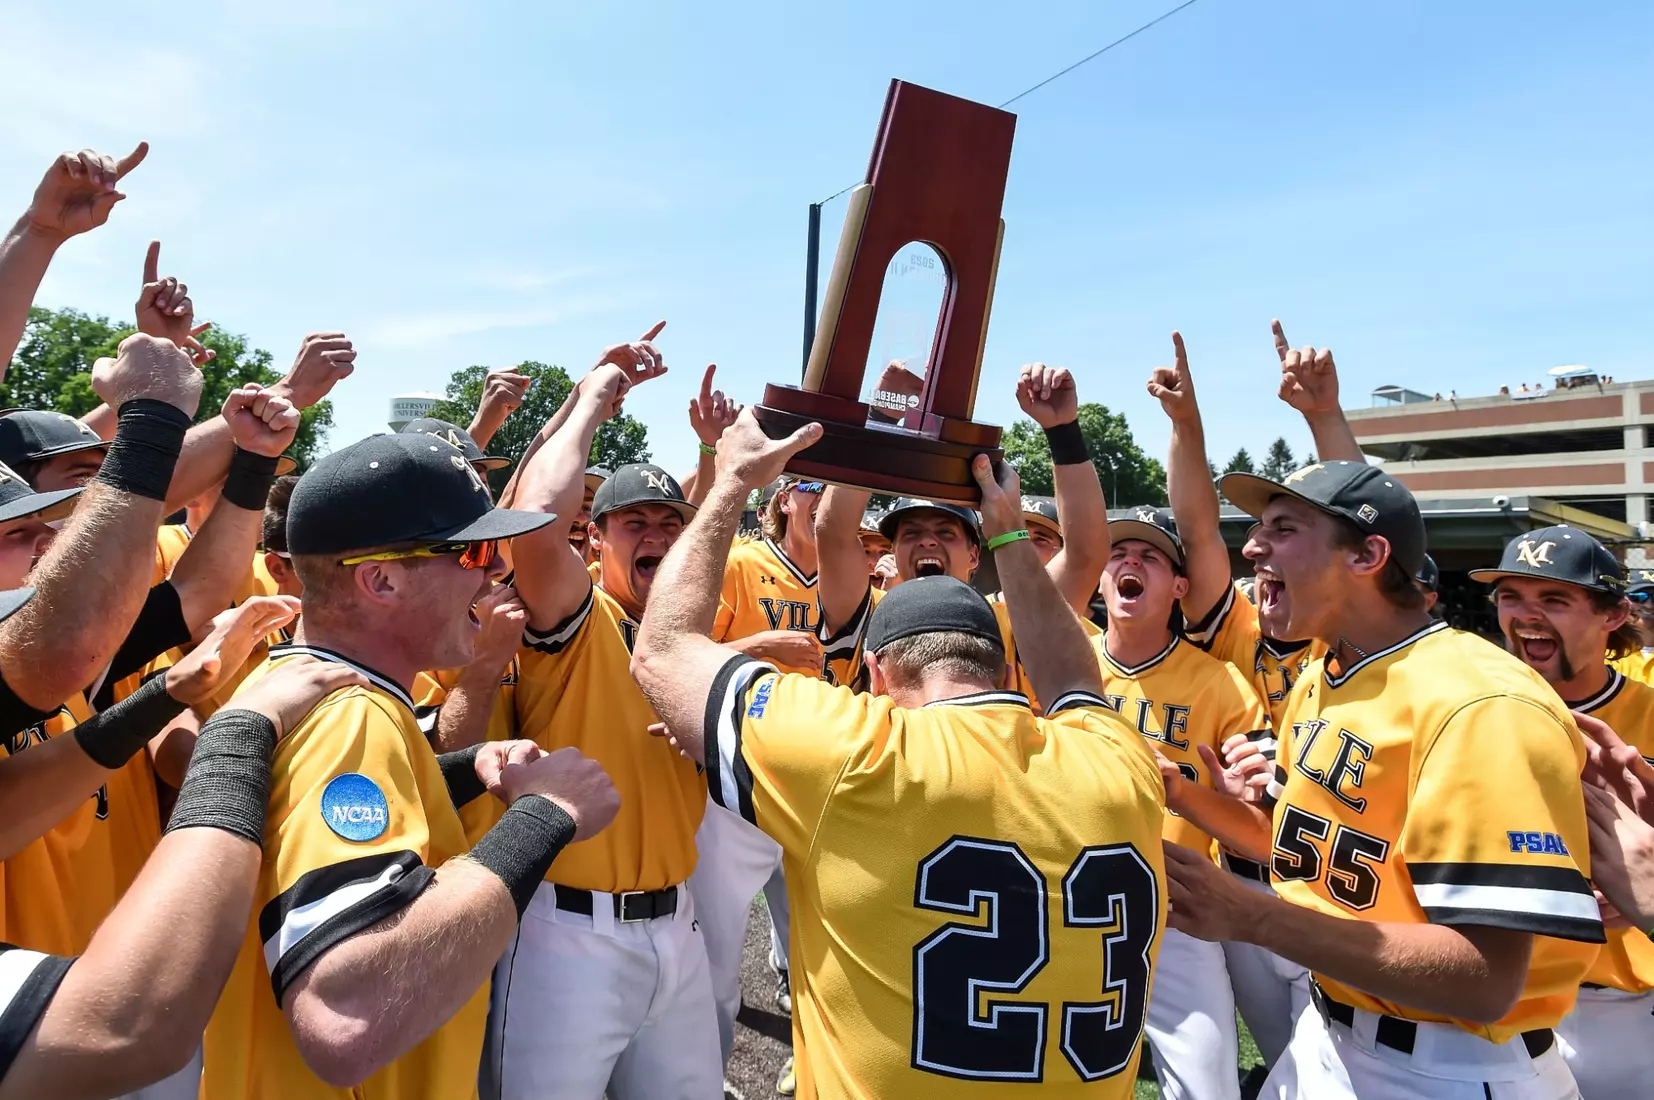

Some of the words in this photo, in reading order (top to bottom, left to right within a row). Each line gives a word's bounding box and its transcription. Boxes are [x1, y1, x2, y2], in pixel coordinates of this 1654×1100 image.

[759, 598, 818, 632] VIL
[332, 805, 385, 825] NCAA
[1271, 803, 1390, 911] 55
[911, 834, 1159, 1083] 23
